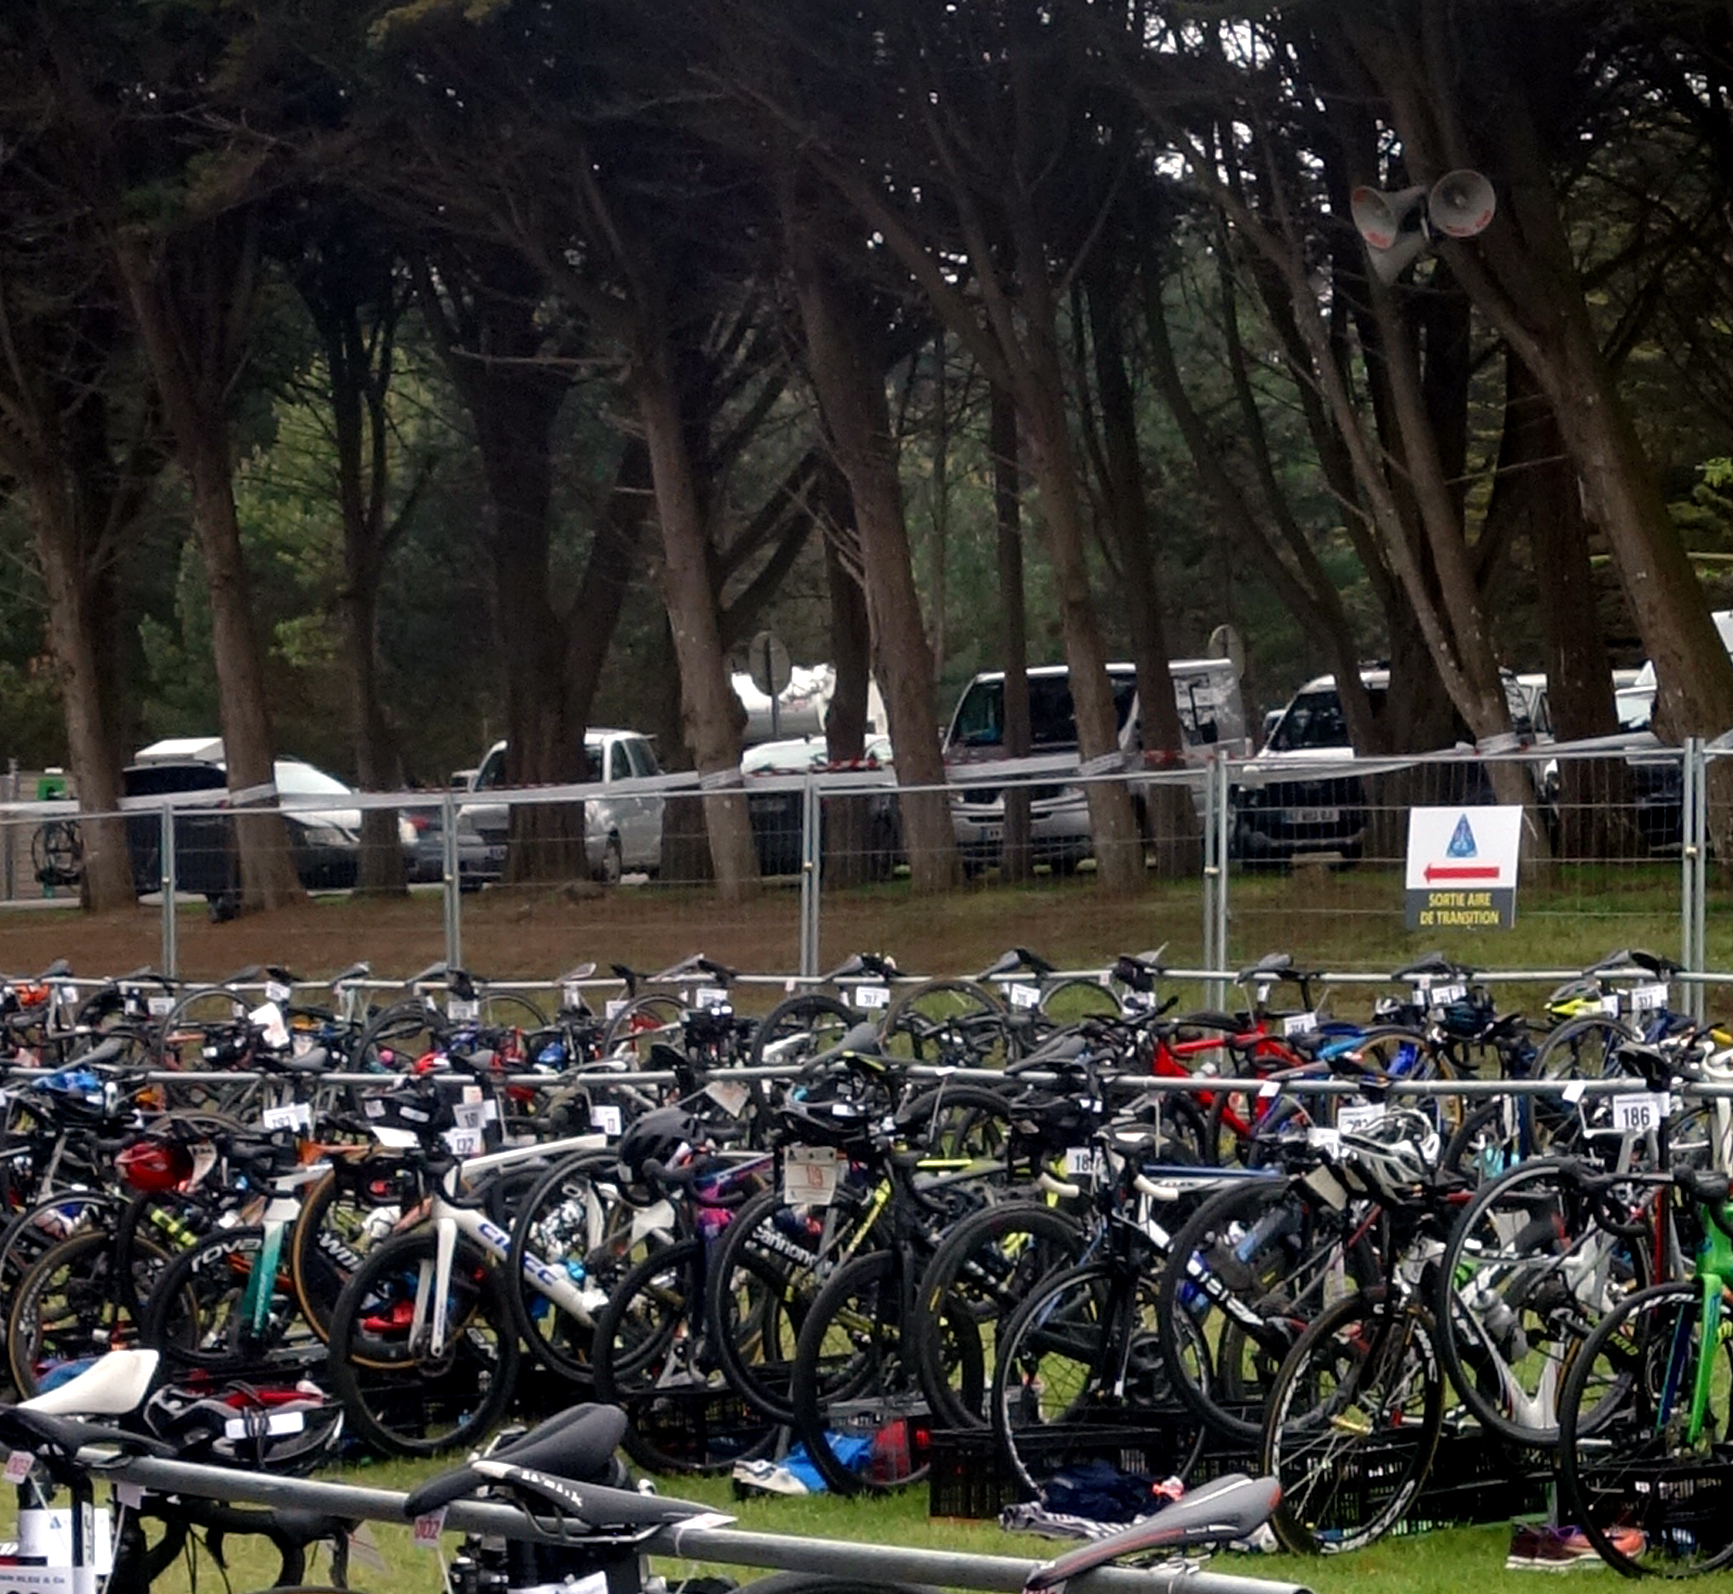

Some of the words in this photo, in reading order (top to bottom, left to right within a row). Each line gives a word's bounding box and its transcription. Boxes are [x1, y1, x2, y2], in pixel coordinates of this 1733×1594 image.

[1429, 893, 1465, 907] SORTIE
[1467, 893, 1491, 907] AIRE
[1420, 911, 1435, 925] DE
[1437, 911, 1499, 925] TRANSITION
[1622, 1106, 1650, 1127] 186
[190, 1237, 263, 1273] rova
